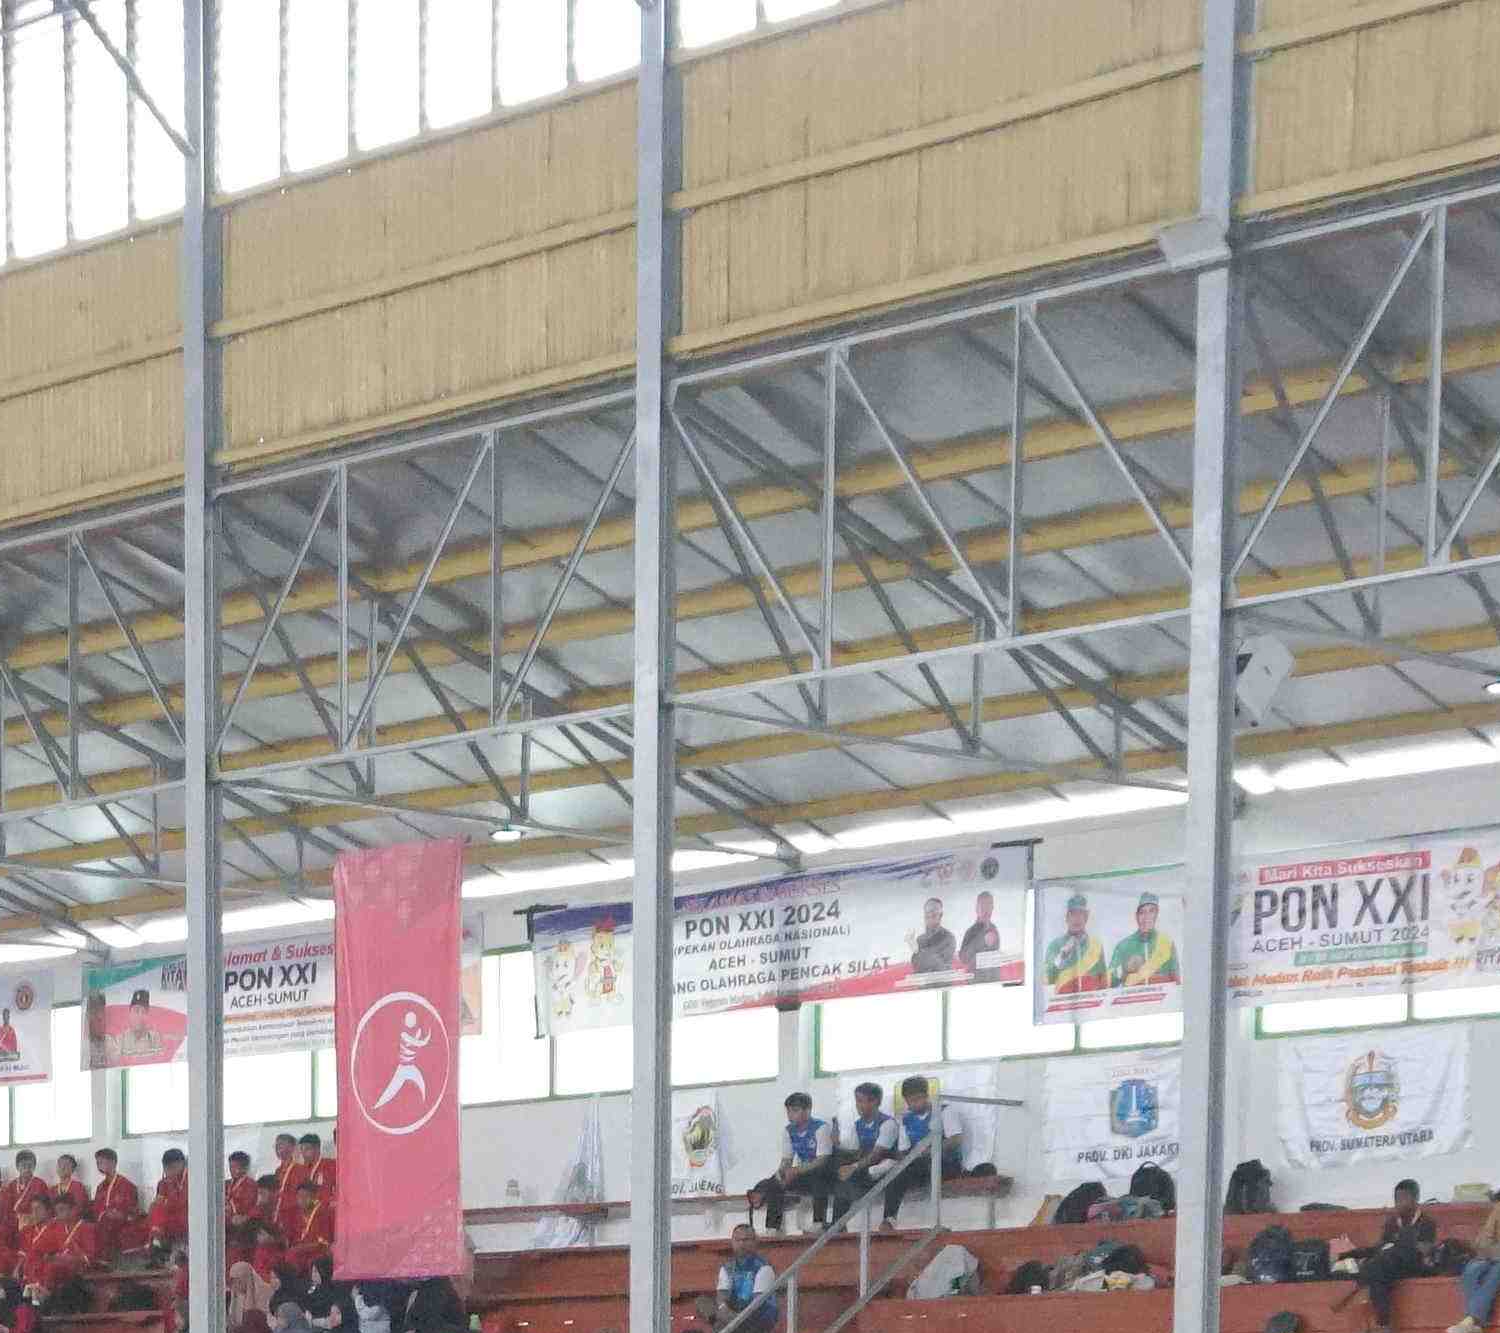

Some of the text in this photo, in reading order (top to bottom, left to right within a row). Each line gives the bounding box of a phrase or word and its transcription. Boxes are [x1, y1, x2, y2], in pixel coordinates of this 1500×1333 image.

[1263, 866, 1296, 882] Mari
[684, 899, 841, 940] PON XXI 2024
[1253, 873, 1430, 936] PON XXI
[1252, 936, 1302, 953] ACEH
[1319, 930, 1384, 946] SUMUT
[1391, 924, 1430, 941] 2024
[701, 971, 776, 992] OLAHRAGA
[781, 964, 842, 981] PENCAK
[847, 956, 891, 974] SILAT
[708, 946, 812, 971] ACEH SUMUT
[225, 960, 318, 993] PON XXI
[1136, 1141, 1180, 1159] JAKART
